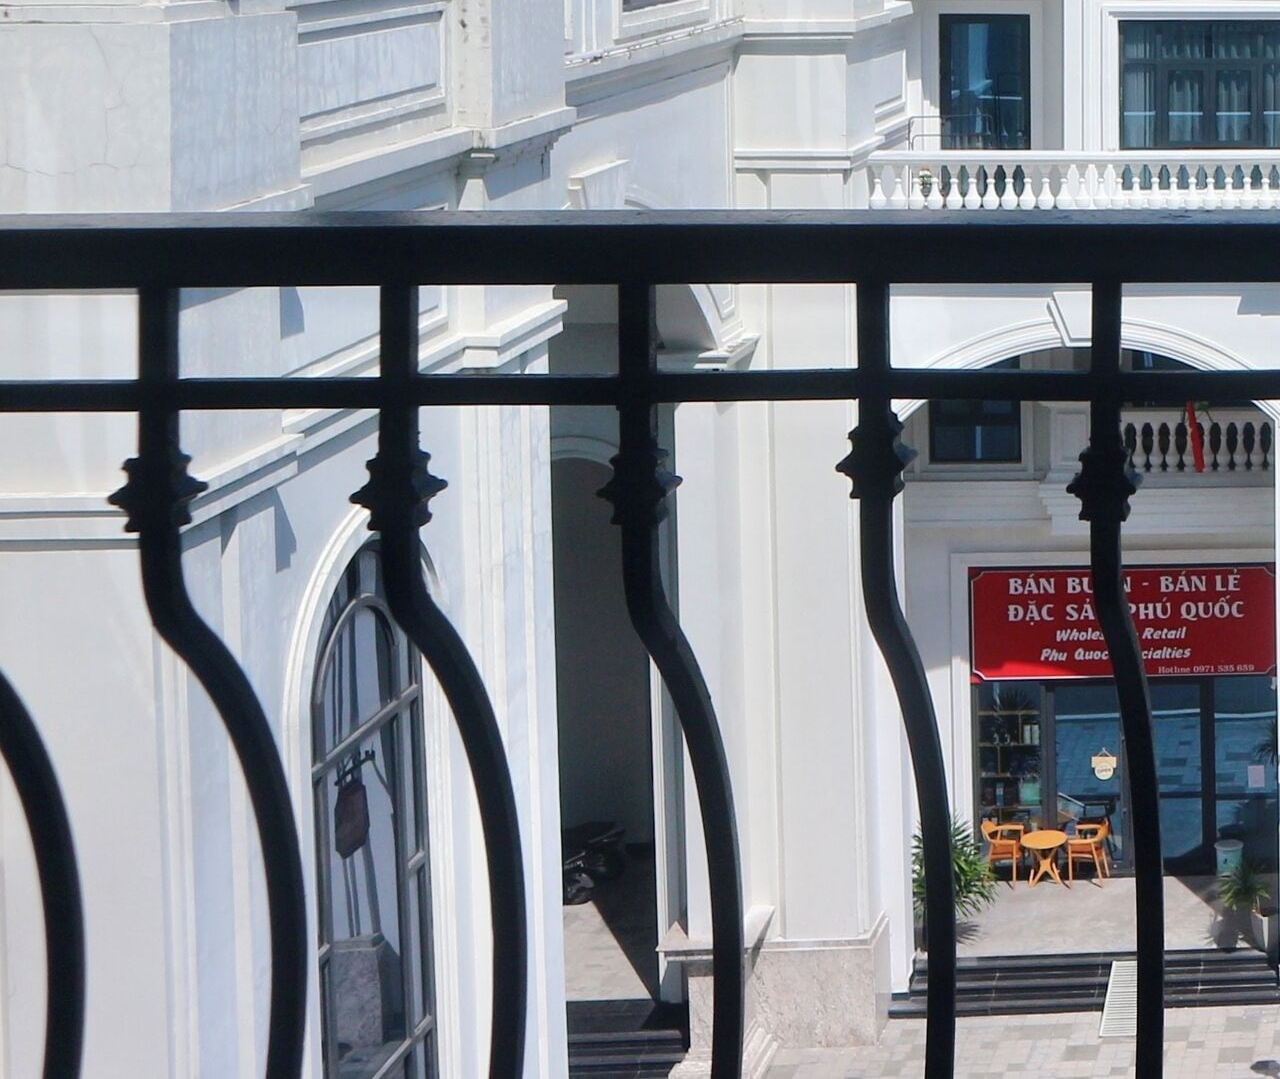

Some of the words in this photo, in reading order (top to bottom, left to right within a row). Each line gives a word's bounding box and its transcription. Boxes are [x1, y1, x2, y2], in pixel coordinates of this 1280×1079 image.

[1008, 573, 1055, 595] BÁN
[1159, 570, 1206, 592] BÁN
[1215, 568, 1240, 591] LẺ
[1008, 600, 1054, 625] ĐẶC
[1065, 598, 1096, 621] SẢ
[1180, 595, 1244, 621] QUỐC
[1142, 626, 1187, 639] Retail
[1040, 648, 1067, 661] Phu
[1074, 647, 1109, 660] Quoc
